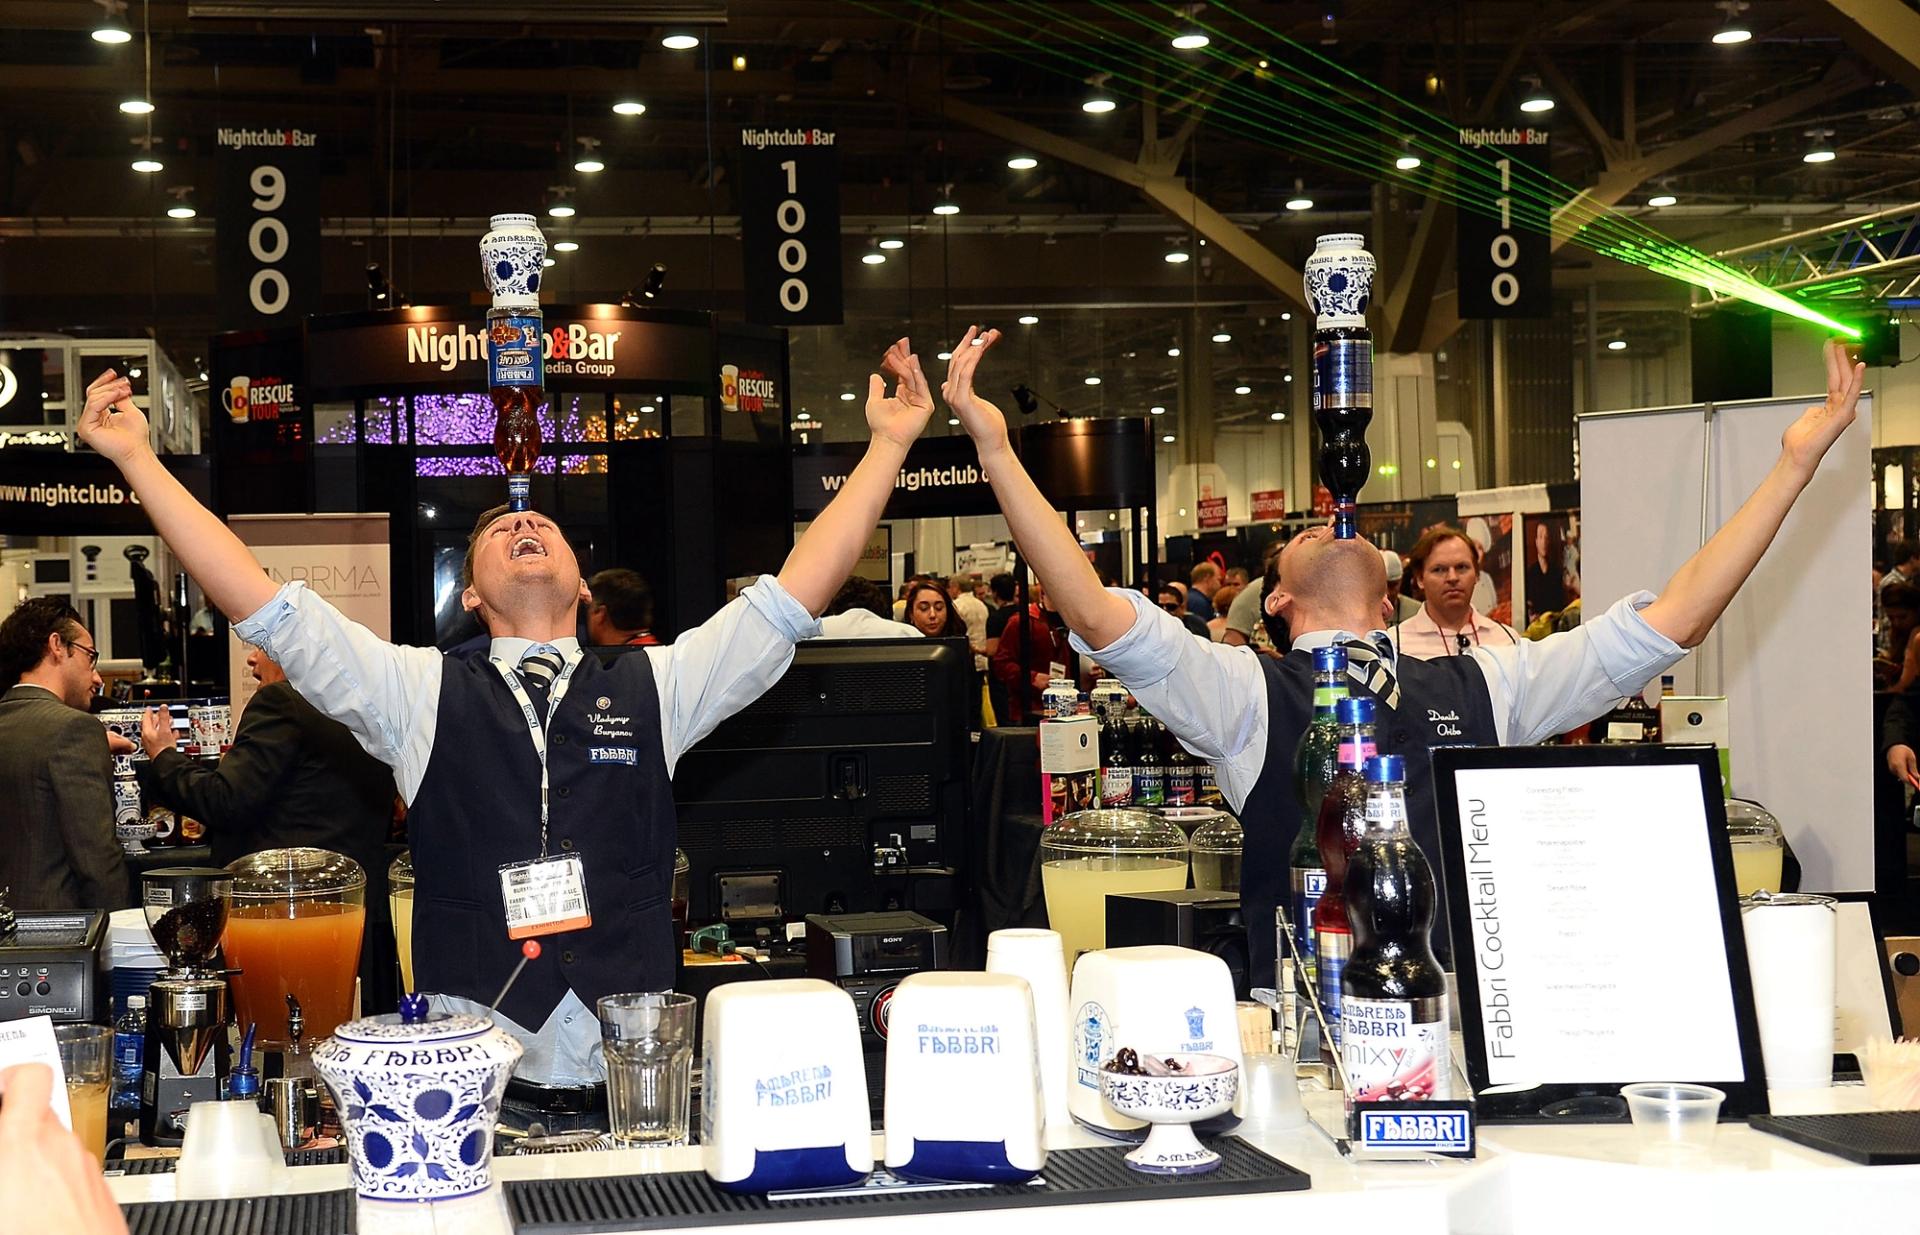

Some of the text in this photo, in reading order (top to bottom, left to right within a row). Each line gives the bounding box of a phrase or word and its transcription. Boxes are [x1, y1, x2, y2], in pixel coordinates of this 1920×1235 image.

[545, 361, 615, 377] edia Group
[251, 384, 294, 405] RESCUE
[739, 378, 775, 398] RESCUE
[590, 748, 637, 762] FABBRI
[1467, 799, 1516, 1058] Fabbri Cocktail Menu
[29, 1007, 77, 1015] SIMONELLI
[1343, 1017, 1406, 1037] FABBRI
[919, 1036, 1000, 1055] FABBRI
[1180, 1041, 1213, 1052] FABBRI
[1343, 1040, 1407, 1077] mixy
[757, 1081, 832, 1107] FABBRI
[1367, 1116, 1463, 1141] FABBRI
